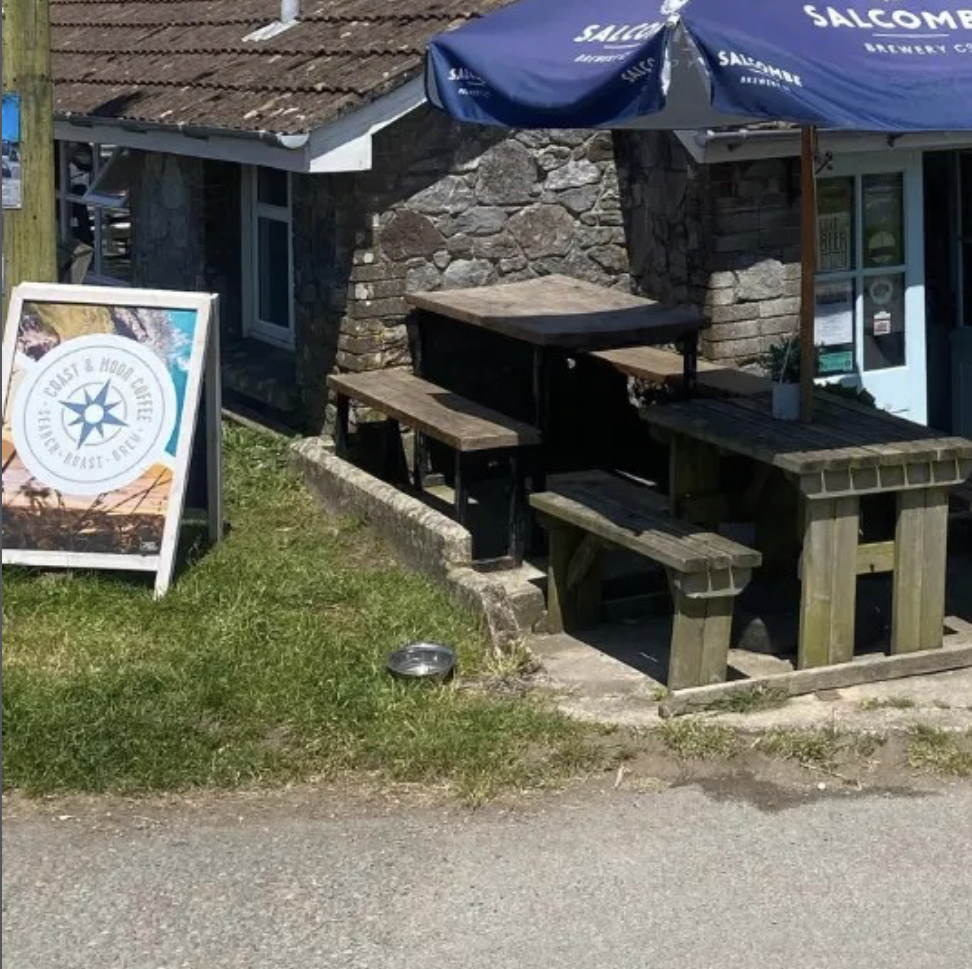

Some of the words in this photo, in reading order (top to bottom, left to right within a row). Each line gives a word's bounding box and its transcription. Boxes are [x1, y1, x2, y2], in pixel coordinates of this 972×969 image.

[573, 21, 665, 42] SALCO
[863, 42, 947, 55] BREWERY
[718, 50, 803, 87] SALCOMBE
[43, 362, 80, 397] COAST
[84, 357, 94, 373] &
[99, 357, 135, 382] MOOR
[129, 377, 154, 423] COFFEE
[37, 409, 61, 456] SEARCH
[62, 454, 104, 470] ROAST
[111, 432, 141, 462] BREW
